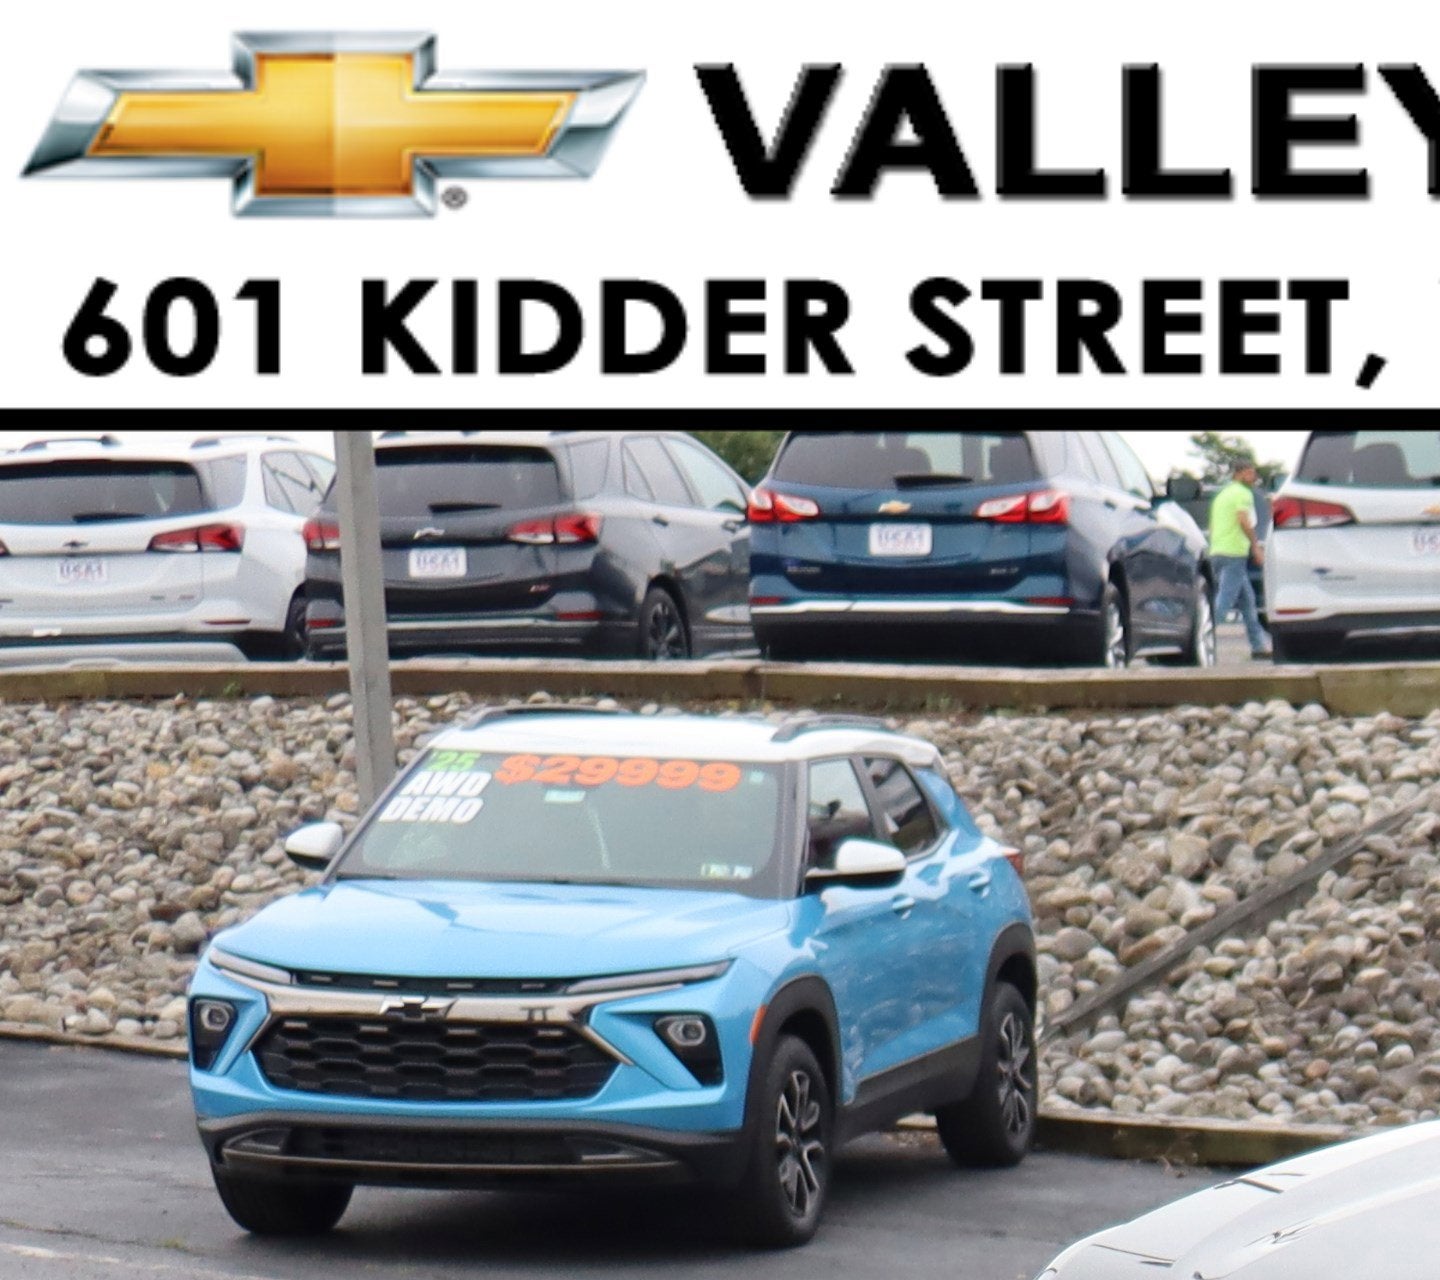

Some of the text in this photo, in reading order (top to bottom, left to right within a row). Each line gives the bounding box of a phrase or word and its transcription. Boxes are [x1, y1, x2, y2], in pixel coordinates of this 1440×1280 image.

[398, 770, 493, 798] AWD
[493, 752, 742, 793] $29999
[377, 797, 485, 824] DEMO
